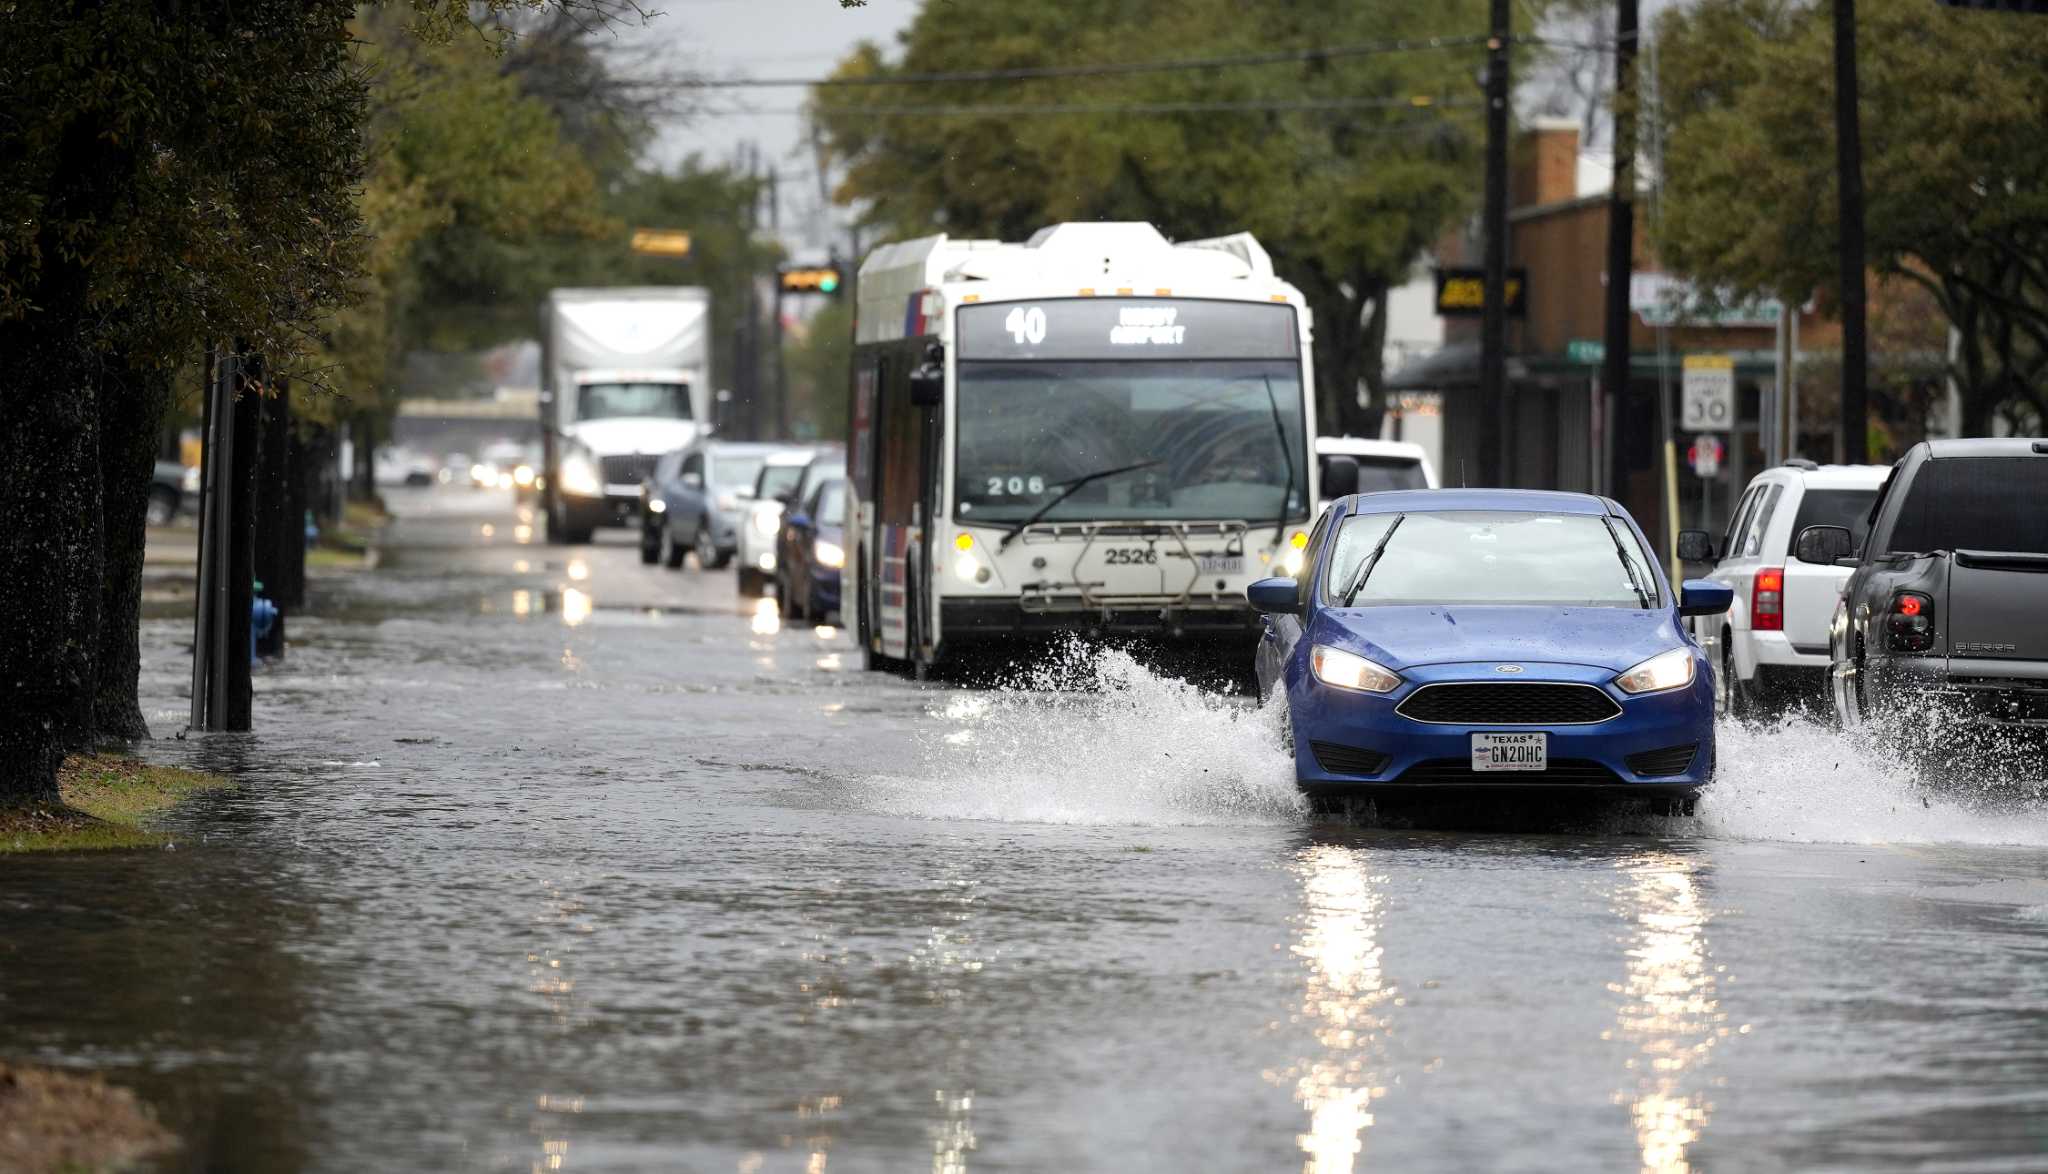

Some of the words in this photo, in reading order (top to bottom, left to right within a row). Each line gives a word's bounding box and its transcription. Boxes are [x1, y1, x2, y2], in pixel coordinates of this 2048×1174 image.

[1005, 307, 1047, 344] 40
[1689, 399, 1726, 422] 30
[987, 476, 1045, 495] 206
[1105, 548, 1158, 565] 2526
[1955, 641, 2017, 652] SIERRA
[1491, 735, 1527, 744] TEXAS
